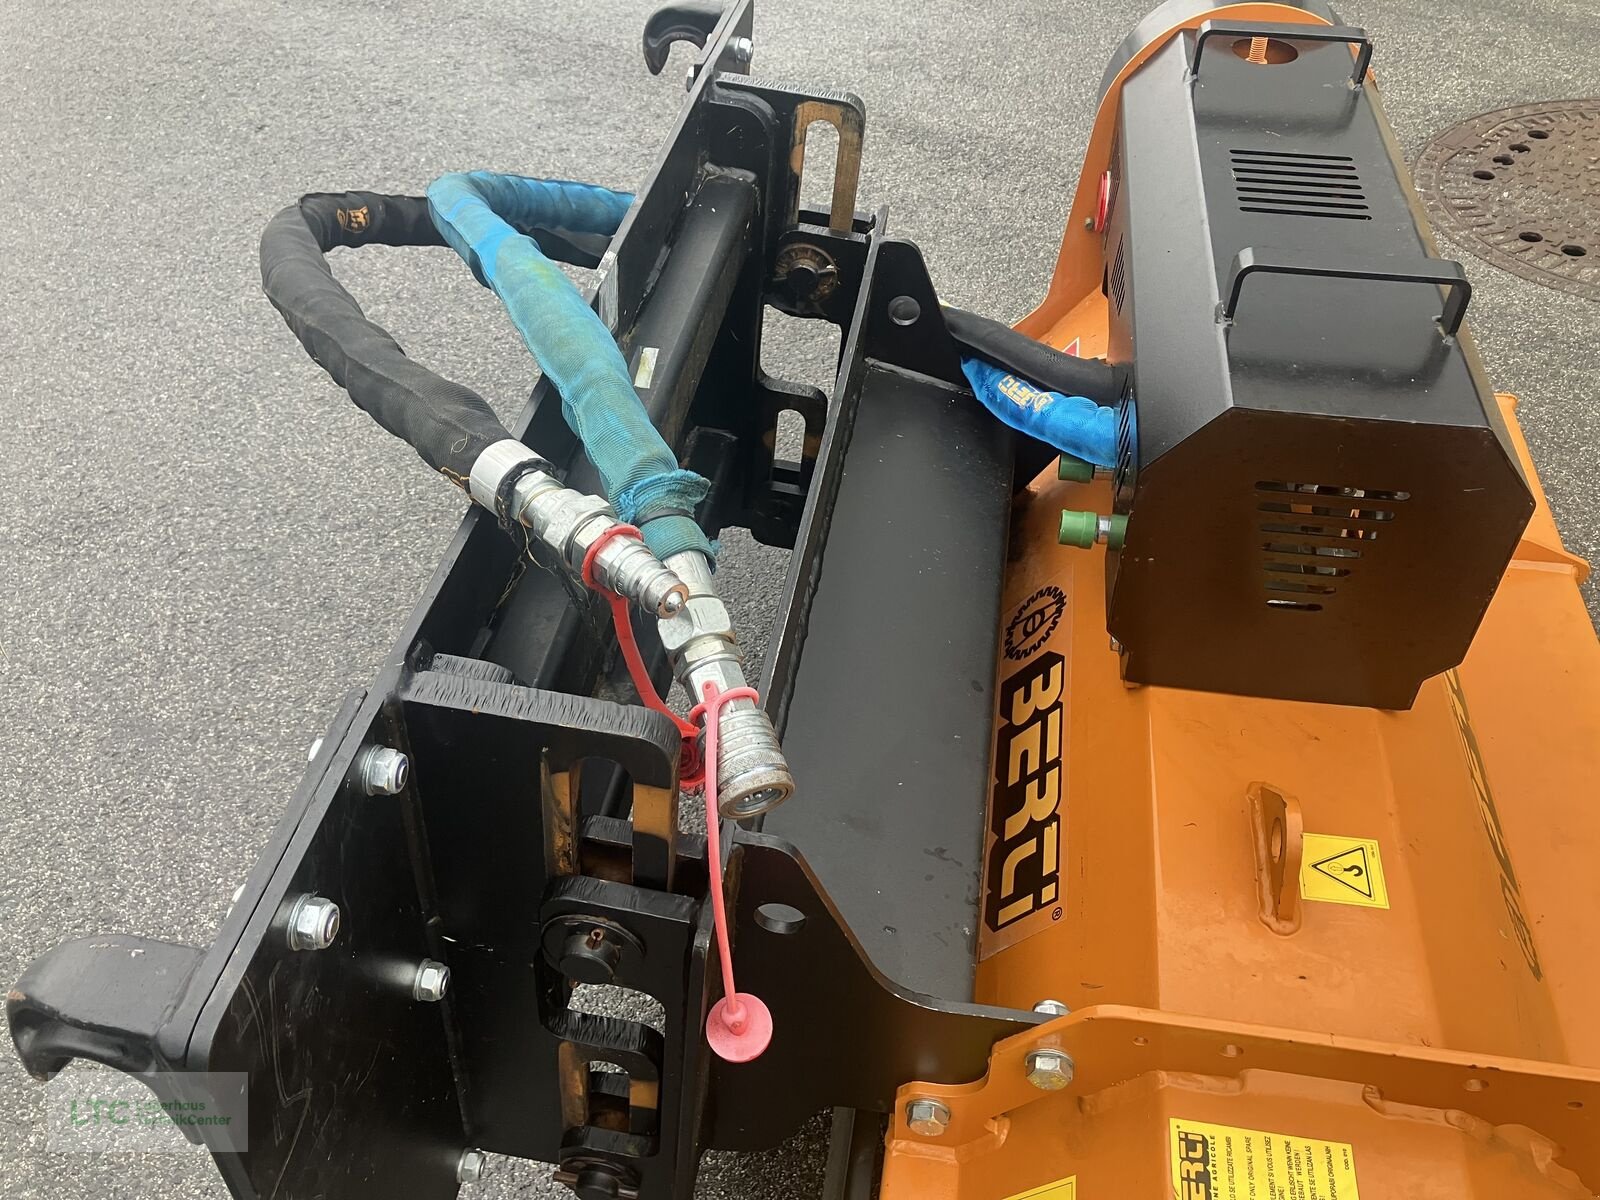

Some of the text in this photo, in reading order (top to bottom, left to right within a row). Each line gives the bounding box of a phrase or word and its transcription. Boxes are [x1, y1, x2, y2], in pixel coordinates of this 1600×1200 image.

[1244, 1136, 1252, 1153] SPARE
[1263, 1136, 1273, 1157] UTILISEZ
[1210, 1135, 1218, 1181] AGRICOLE
[1246, 1155, 1254, 1180] ORIGINAL
[1266, 1157, 1274, 1171] VOUS
[1306, 1155, 1314, 1178] UTILIZAN
[1226, 1158, 1235, 1185] UTILIZZATE
[1288, 1171, 1297, 1195] ERLISCHT
